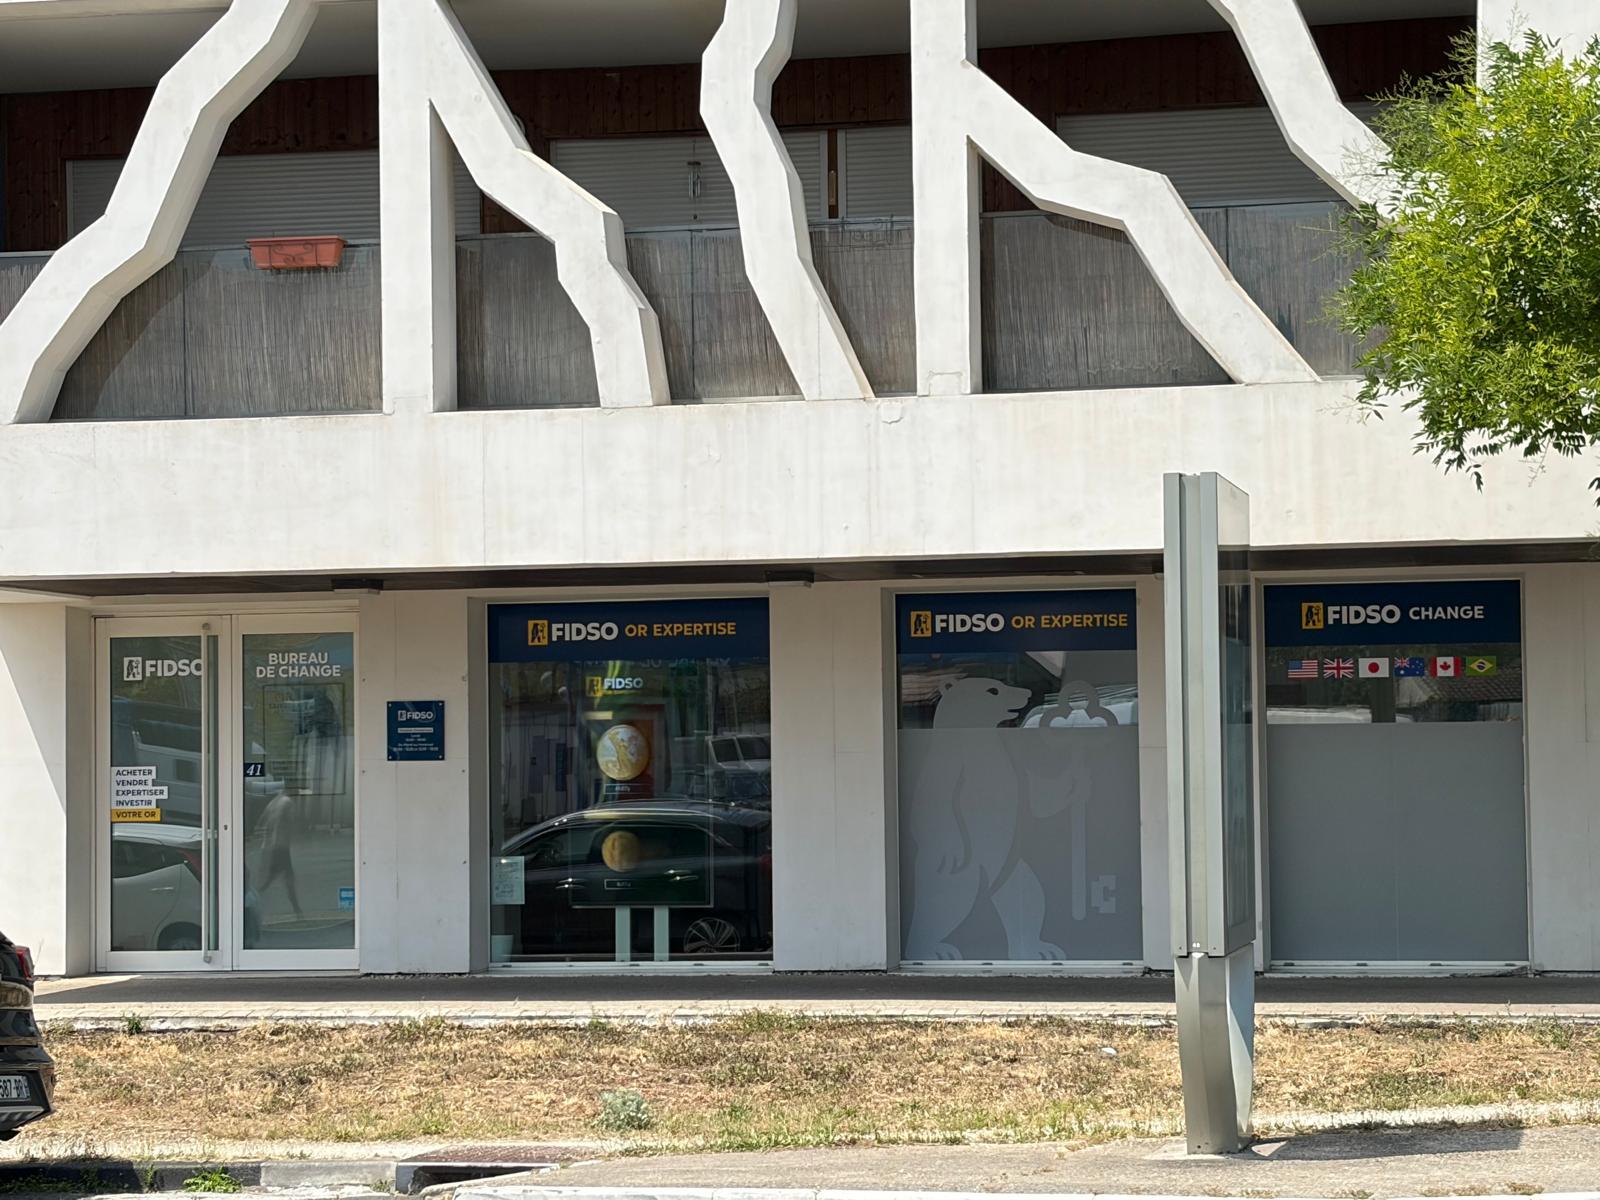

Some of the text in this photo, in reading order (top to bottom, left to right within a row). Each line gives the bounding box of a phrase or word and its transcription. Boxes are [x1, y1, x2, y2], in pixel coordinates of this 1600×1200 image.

[1327, 604, 1485, 625] FIDSO CHANGE
[935, 613, 1128, 633] FIDSO OR EXPERTISE
[551, 622, 737, 641] FIDSO OR EXPERTISE
[268, 652, 328, 665] BUREAU
[256, 665, 341, 678] DE CHANGE
[603, 677, 644, 690] FIDSO
[407, 711, 434, 720] FIDSO
[246, 764, 262, 776] 41
[115, 779, 149, 787] VENDRE
[115, 789, 165, 797] EXPERTISER
[115, 799, 153, 807] INVESTIR
